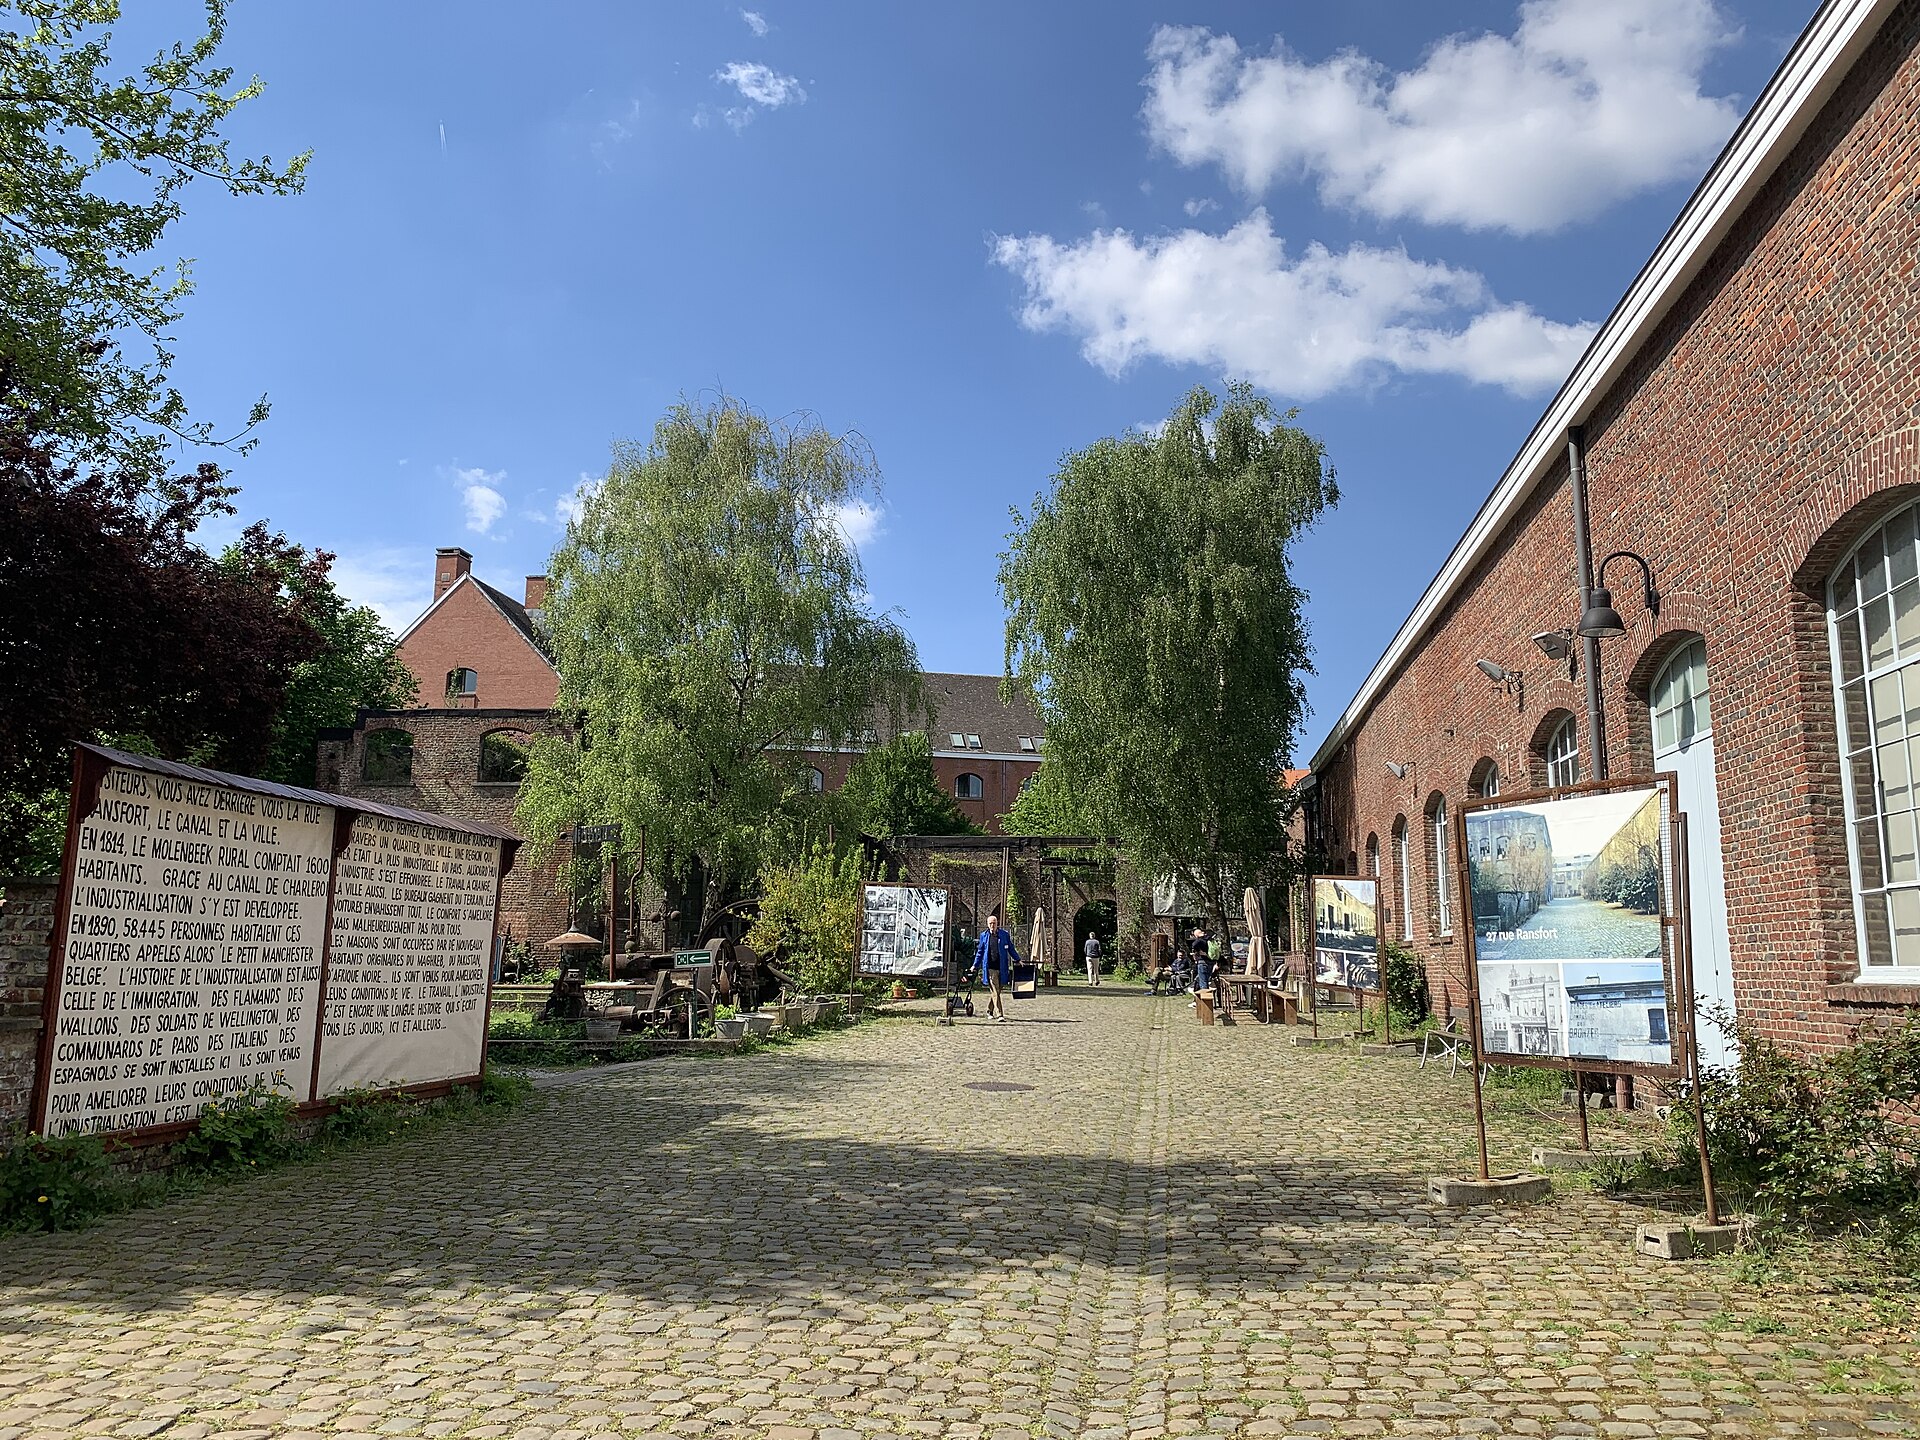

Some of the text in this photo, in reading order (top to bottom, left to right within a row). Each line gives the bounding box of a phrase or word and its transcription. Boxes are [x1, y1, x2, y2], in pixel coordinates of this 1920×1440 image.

[100, 770, 321, 824] SITEURS, VOUS AVEZ DERRIERE VOUS LA RUE
[91, 798, 280, 845] ANSFORT, LE CANAL ET LA VILLE.
[82, 827, 329, 875] EN 1814, LE MOLENBEEK RURAL COMPTAIT 1600
[351, 831, 376, 846] RAVERS
[380, 836, 388, 848] UN
[392, 838, 421, 856] QUARTIER,
[354, 848, 371, 863] ETAIT
[374, 852, 382, 865] LA
[386, 853, 400, 867] PLUS
[78, 858, 329, 897] HABITANTS. GRACE AU CANAL DE CHARLEROI
[336, 863, 375, 881] 'INDUSTRIE
[378, 869, 397, 883] S'EST
[436, 877, 443, 888] LE
[75, 886, 302, 919] L'INDUSTRIALISATION S'Y EST DEVELOPPEE.
[346, 883, 362, 896] VILLE
[392, 888, 402, 900] LES
[486, 895, 495, 906] LES
[333, 899, 363, 913] VOITURES
[364, 902, 404, 917] ENVAHISSENT
[427, 907, 434, 919] LE
[71, 914, 301, 942] EN 1890, 58.445 PERSONNES HABITAIENT CES
[352, 918, 415, 934] MALHEUREUSEMENT
[418, 922, 428, 935] PAS
[431, 923, 445, 935] POUR
[1486, 927, 1558, 942] 27 rue Ransfort
[69, 941, 130, 963] QUARTIERS
[136, 944, 181, 962] APPELES
[183, 945, 215, 963] ALORS
[237, 947, 258, 963] PETIT
[262, 947, 313, 963] MANCHESTER
[347, 936, 378, 949] MAISONS
[383, 937, 400, 950] SONT
[403, 938, 434, 950] OCCUPEES
[437, 939, 447, 951] PAR
[449, 939, 455, 951] DE
[367, 953, 404, 966] ORIGINAIRES
[406, 955, 414, 966] DU
[119, 966, 176, 986] L'HISTOIRE
[180, 967, 191, 986] DE
[195, 968, 283, 985] L'INDUSTRIALISATION
[286, 967, 301, 982] EST
[391, 970, 454, 983] ILS SONT VENUS POUR
[64, 992, 96, 1010] CELLE
[103, 992, 116, 1010] DE
[211, 990, 228, 1007] DES
[234, 988, 281, 1006] FLAMANDS
[288, 987, 304, 1002] DES
[352, 987, 388, 1000] CONDITIONS
[391, 988, 398, 1000] DE
[419, 987, 426, 999] LE
[349, 1005, 374, 1018] ENCORE
[377, 1004, 389, 1017] UNE
[418, 1002, 441, 1015] HISTOIRE
[446, 1002, 454, 1014] QUI
[61, 1016, 122, 1037] WALLONS,
[131, 1016, 151, 1034] DES
[156, 1012, 198, 1032] SOLDATS
[203, 1012, 214, 1028] DE
[287, 1007, 301, 1022] DES
[323, 1023, 340, 1036] TOUS
[343, 1022, 355, 1036] LES
[360, 1022, 384, 1036] JOURS,
[390, 1021, 399, 1033] ICI
[403, 1020, 411, 1032] ET
[58, 1027, 296, 1061] COMMUNARDS DE PARIS DES ITALIENS DES
[54, 1047, 300, 1084] ESPAGNOLS SE SONT INSTALLES ICI ILS SONT VENUS
[51, 1093, 81, 1114] POUR
[85, 1087, 147, 1110] AMELIORER
[155, 1082, 187, 1103] LEURS
[193, 1075, 247, 1097] CONDITIONS
[164, 1104, 191, 1122] C'EST
